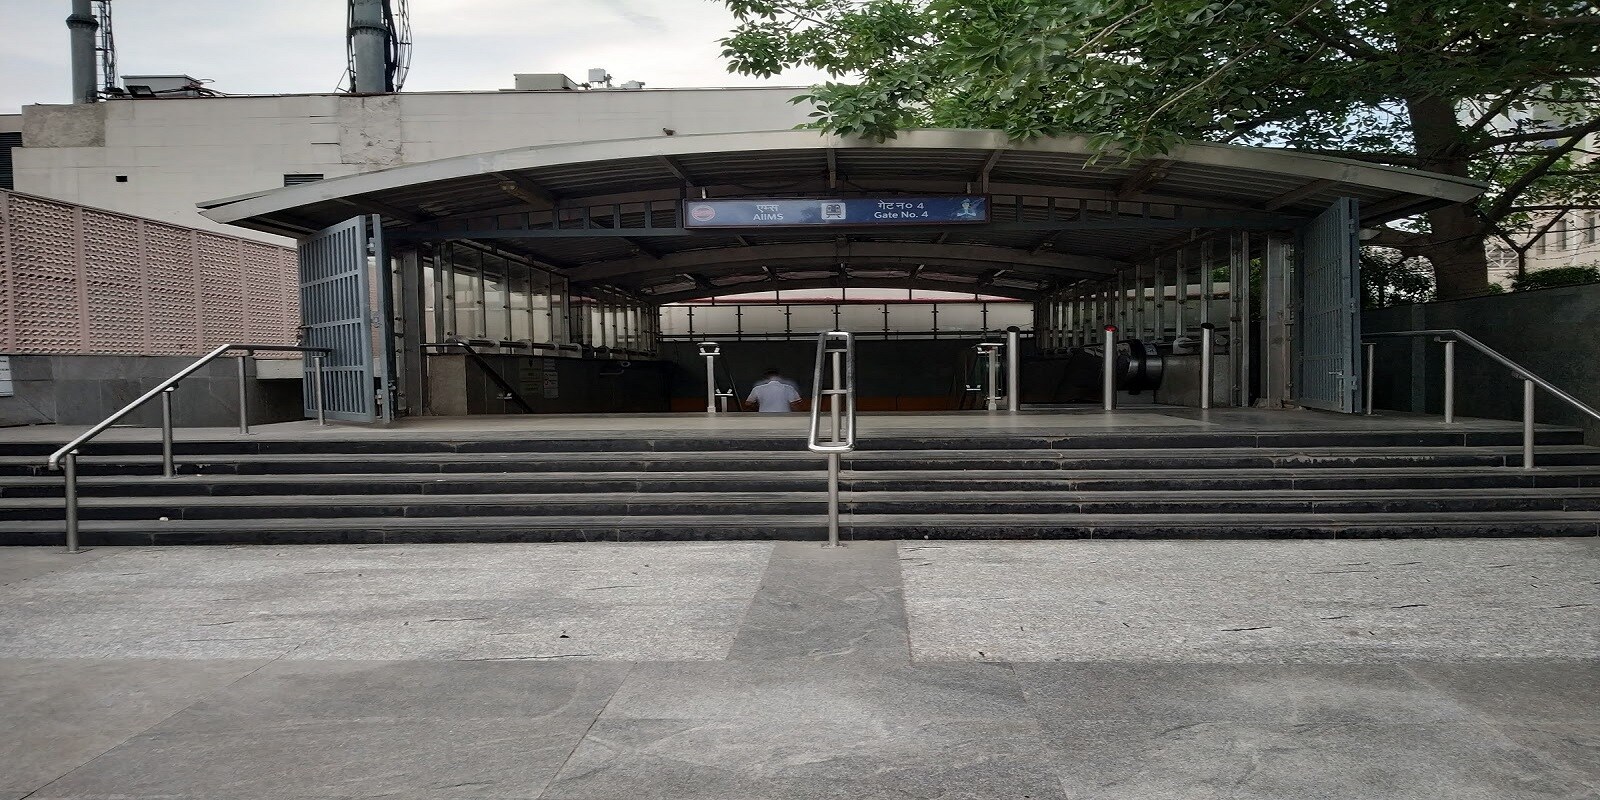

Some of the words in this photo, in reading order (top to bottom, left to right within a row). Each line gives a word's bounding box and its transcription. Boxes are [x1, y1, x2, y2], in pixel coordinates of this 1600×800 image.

[756, 204, 780, 213] एम्स
[877, 200, 894, 210] गेट
[916, 202, 925, 210] 4
[753, 213, 784, 221] AIIMS
[873, 211, 898, 219] Gate
[901, 211, 918, 219] No.
[920, 210, 929, 218] 4
